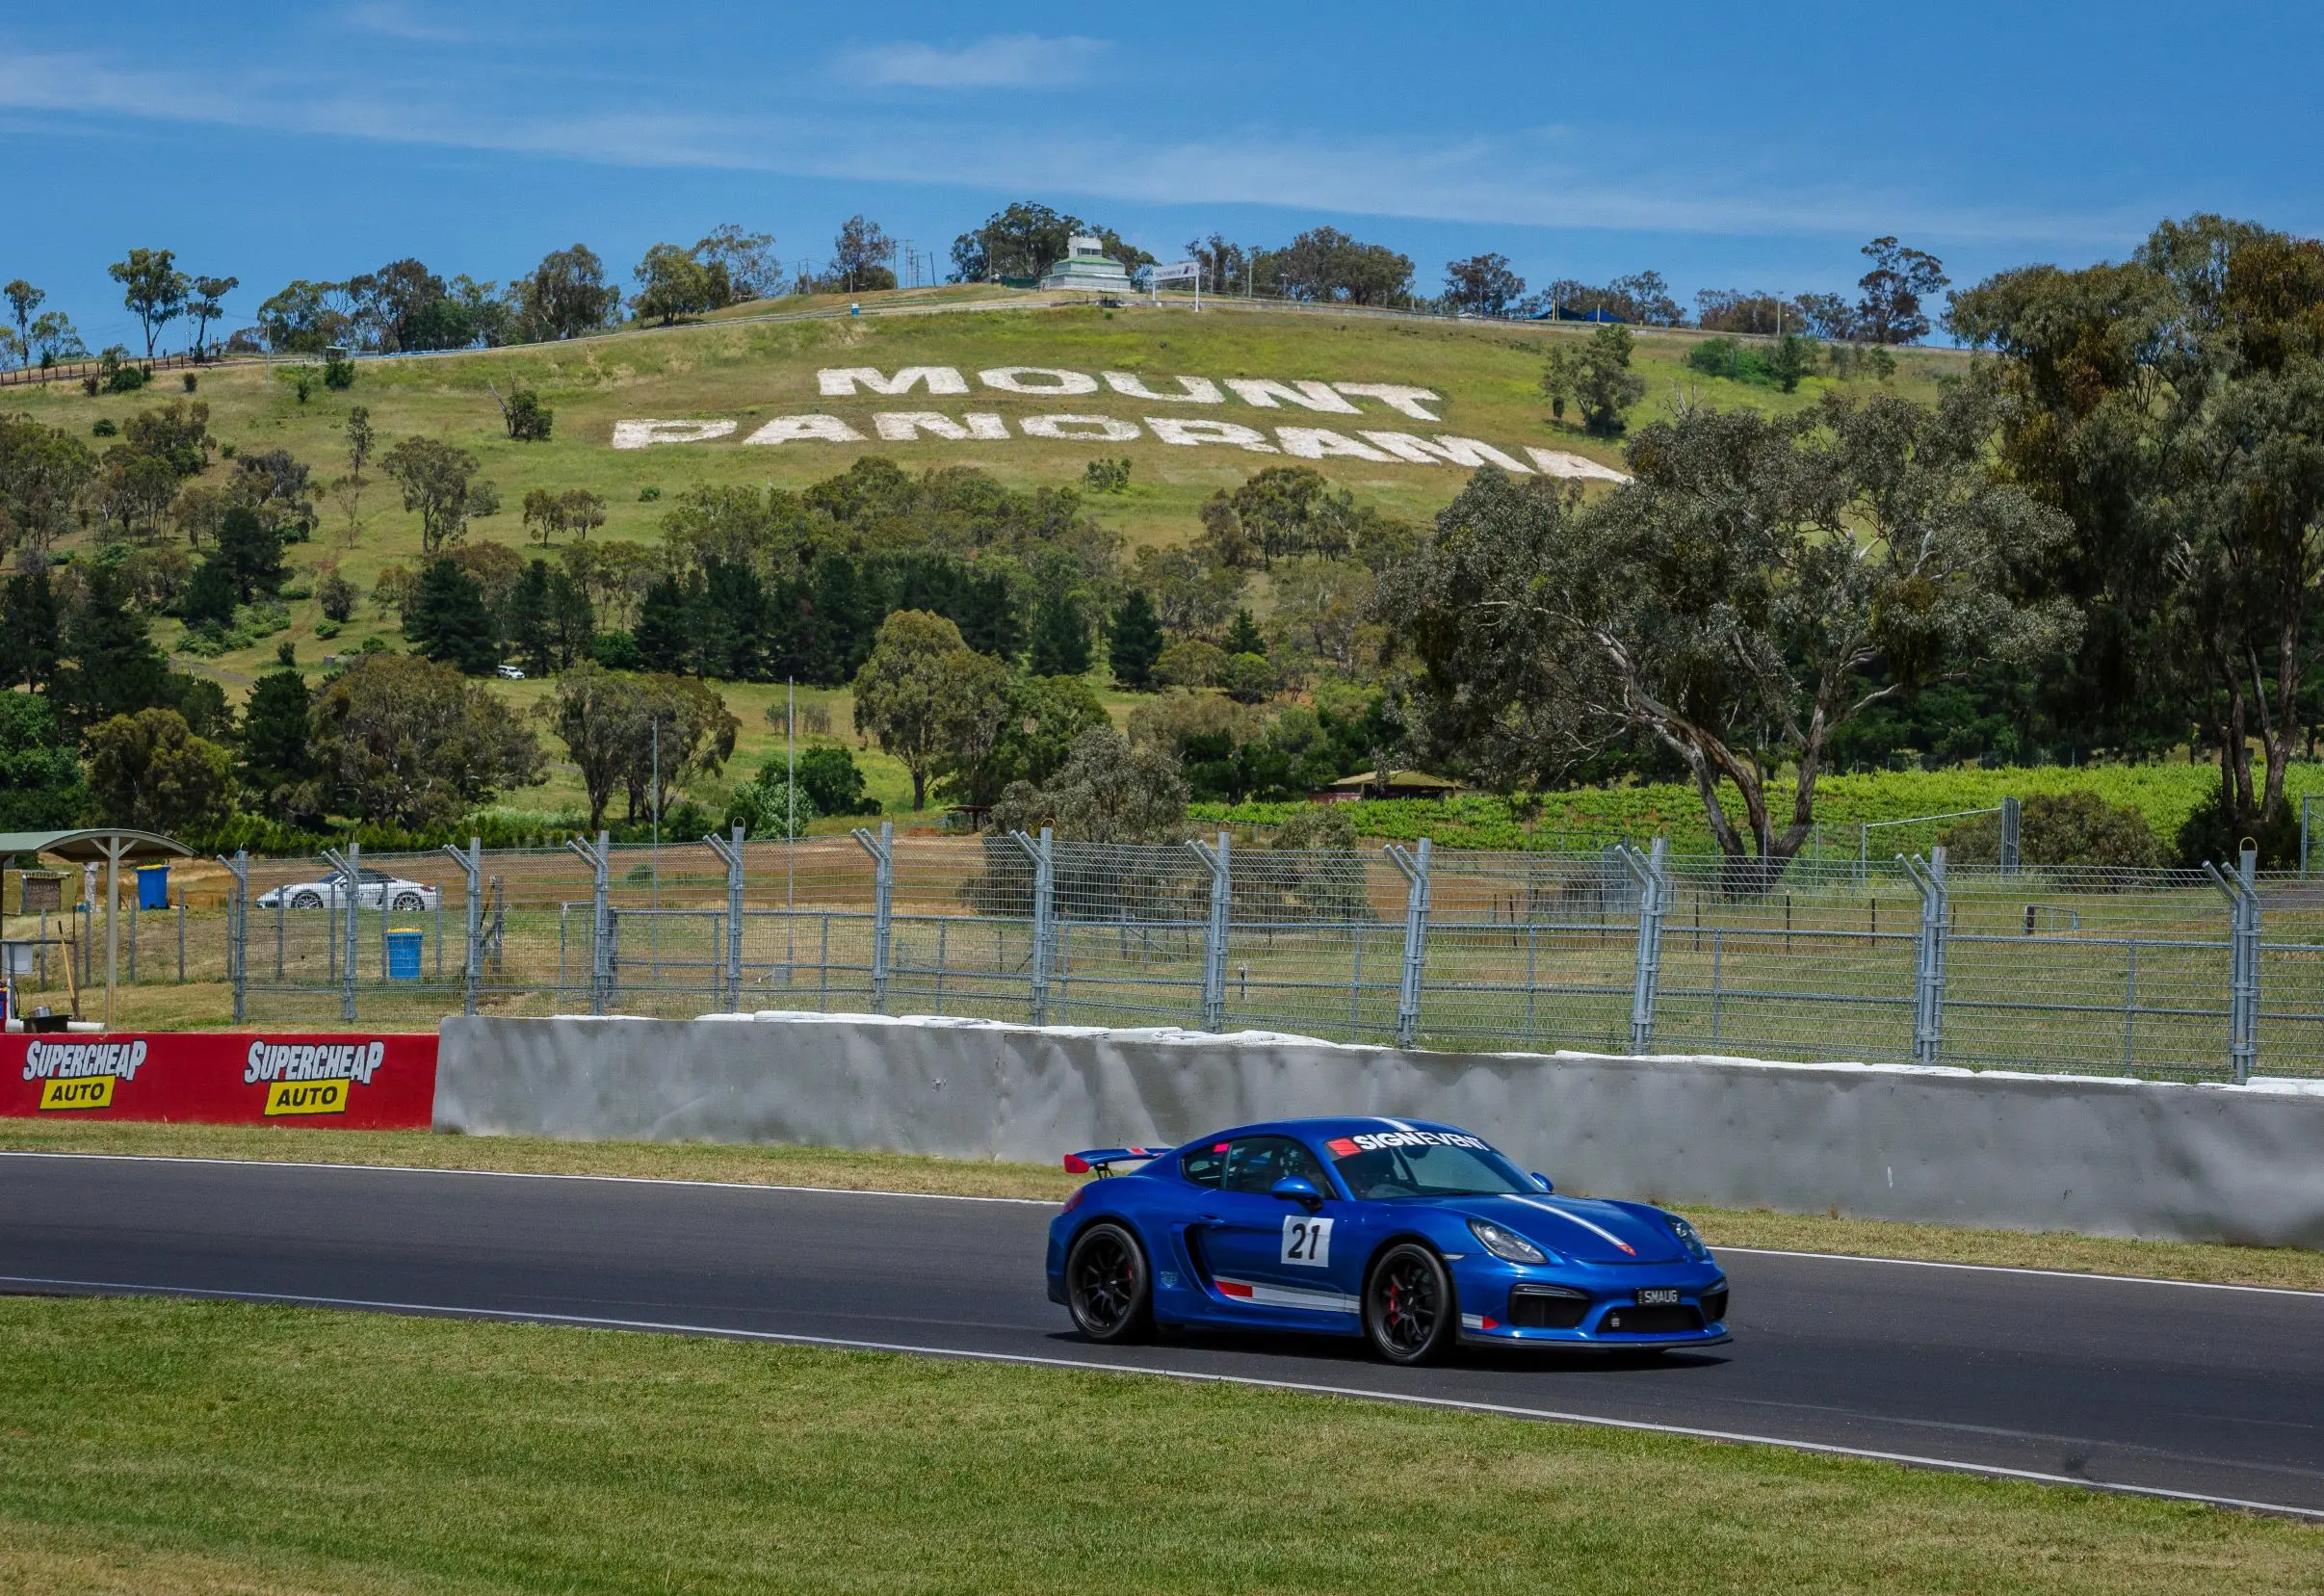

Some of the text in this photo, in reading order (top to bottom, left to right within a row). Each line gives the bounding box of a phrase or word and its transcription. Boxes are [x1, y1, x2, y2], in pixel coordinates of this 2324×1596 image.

[816, 365, 1442, 422] MOUNT
[612, 410, 1635, 484] PANORAMA
[22, 1039, 147, 1082] SUPERCHEAP
[244, 1040, 385, 1085] SUPERCHEAP
[50, 1082, 105, 1102] AUTO
[276, 1086, 338, 1108] AUTO
[1287, 1222, 1320, 1261] 21
[1643, 1290, 1679, 1304] SMAUG
